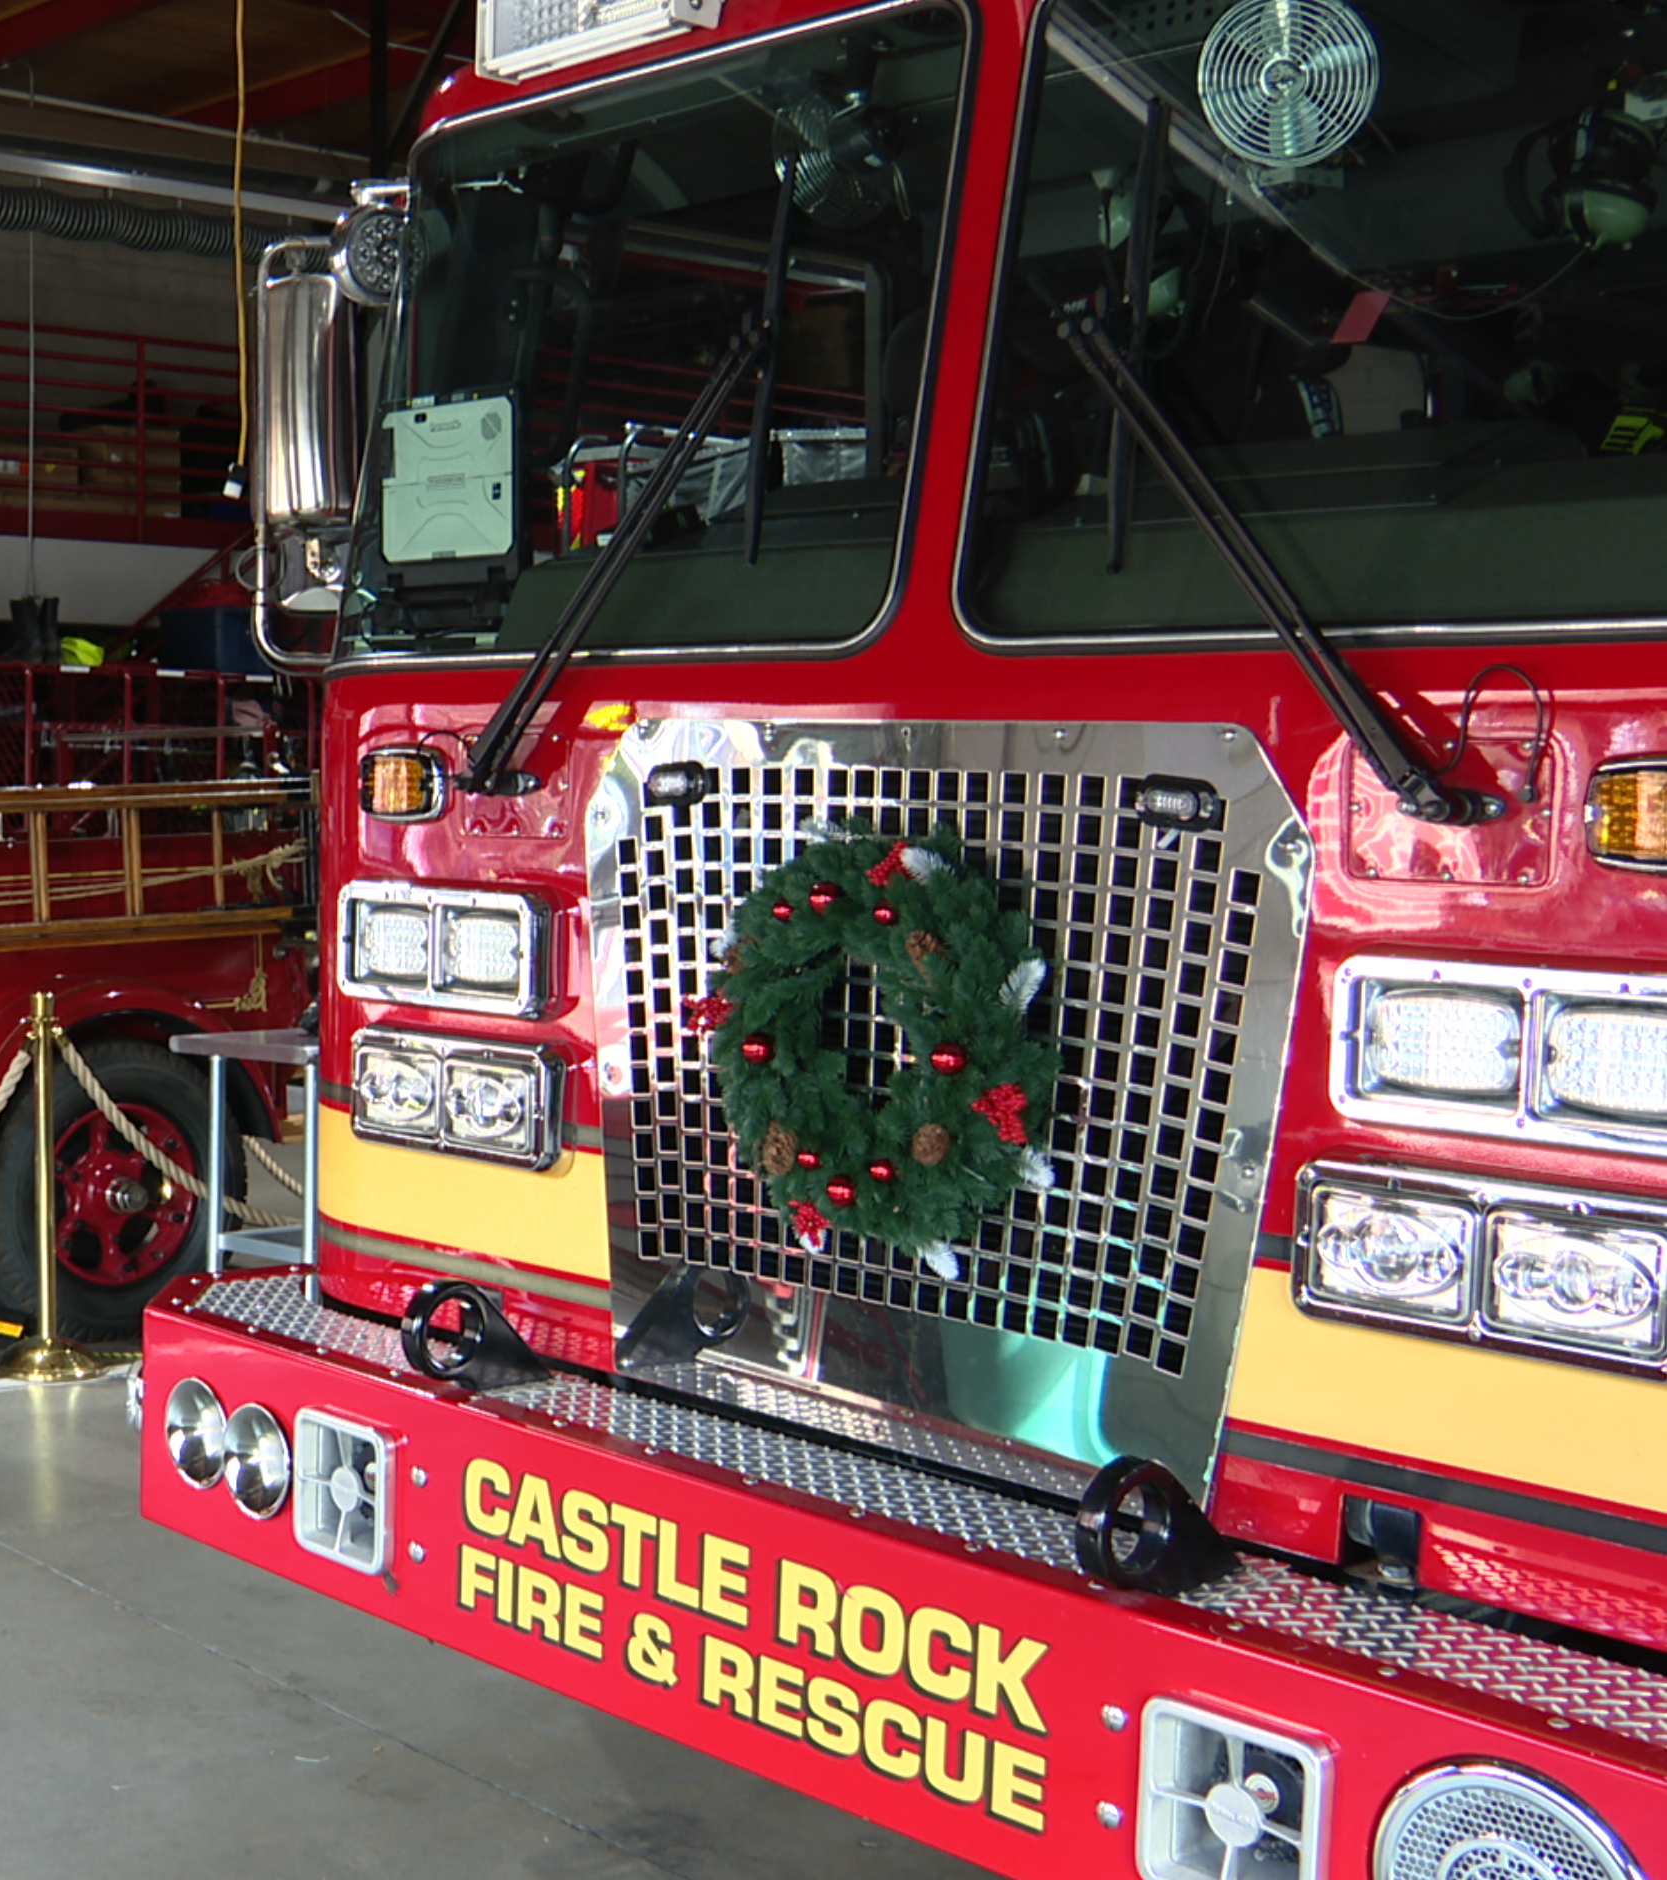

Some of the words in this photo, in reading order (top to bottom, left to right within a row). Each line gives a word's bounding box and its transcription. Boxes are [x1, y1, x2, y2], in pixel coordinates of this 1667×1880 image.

[457, 1543, 604, 1661] FIRE
[625, 1611, 679, 1688] &
[699, 1634, 1047, 1834] RESCUE
[463, 1457, 751, 1629] CASTLE
[774, 1557, 1050, 1735] ROCK
